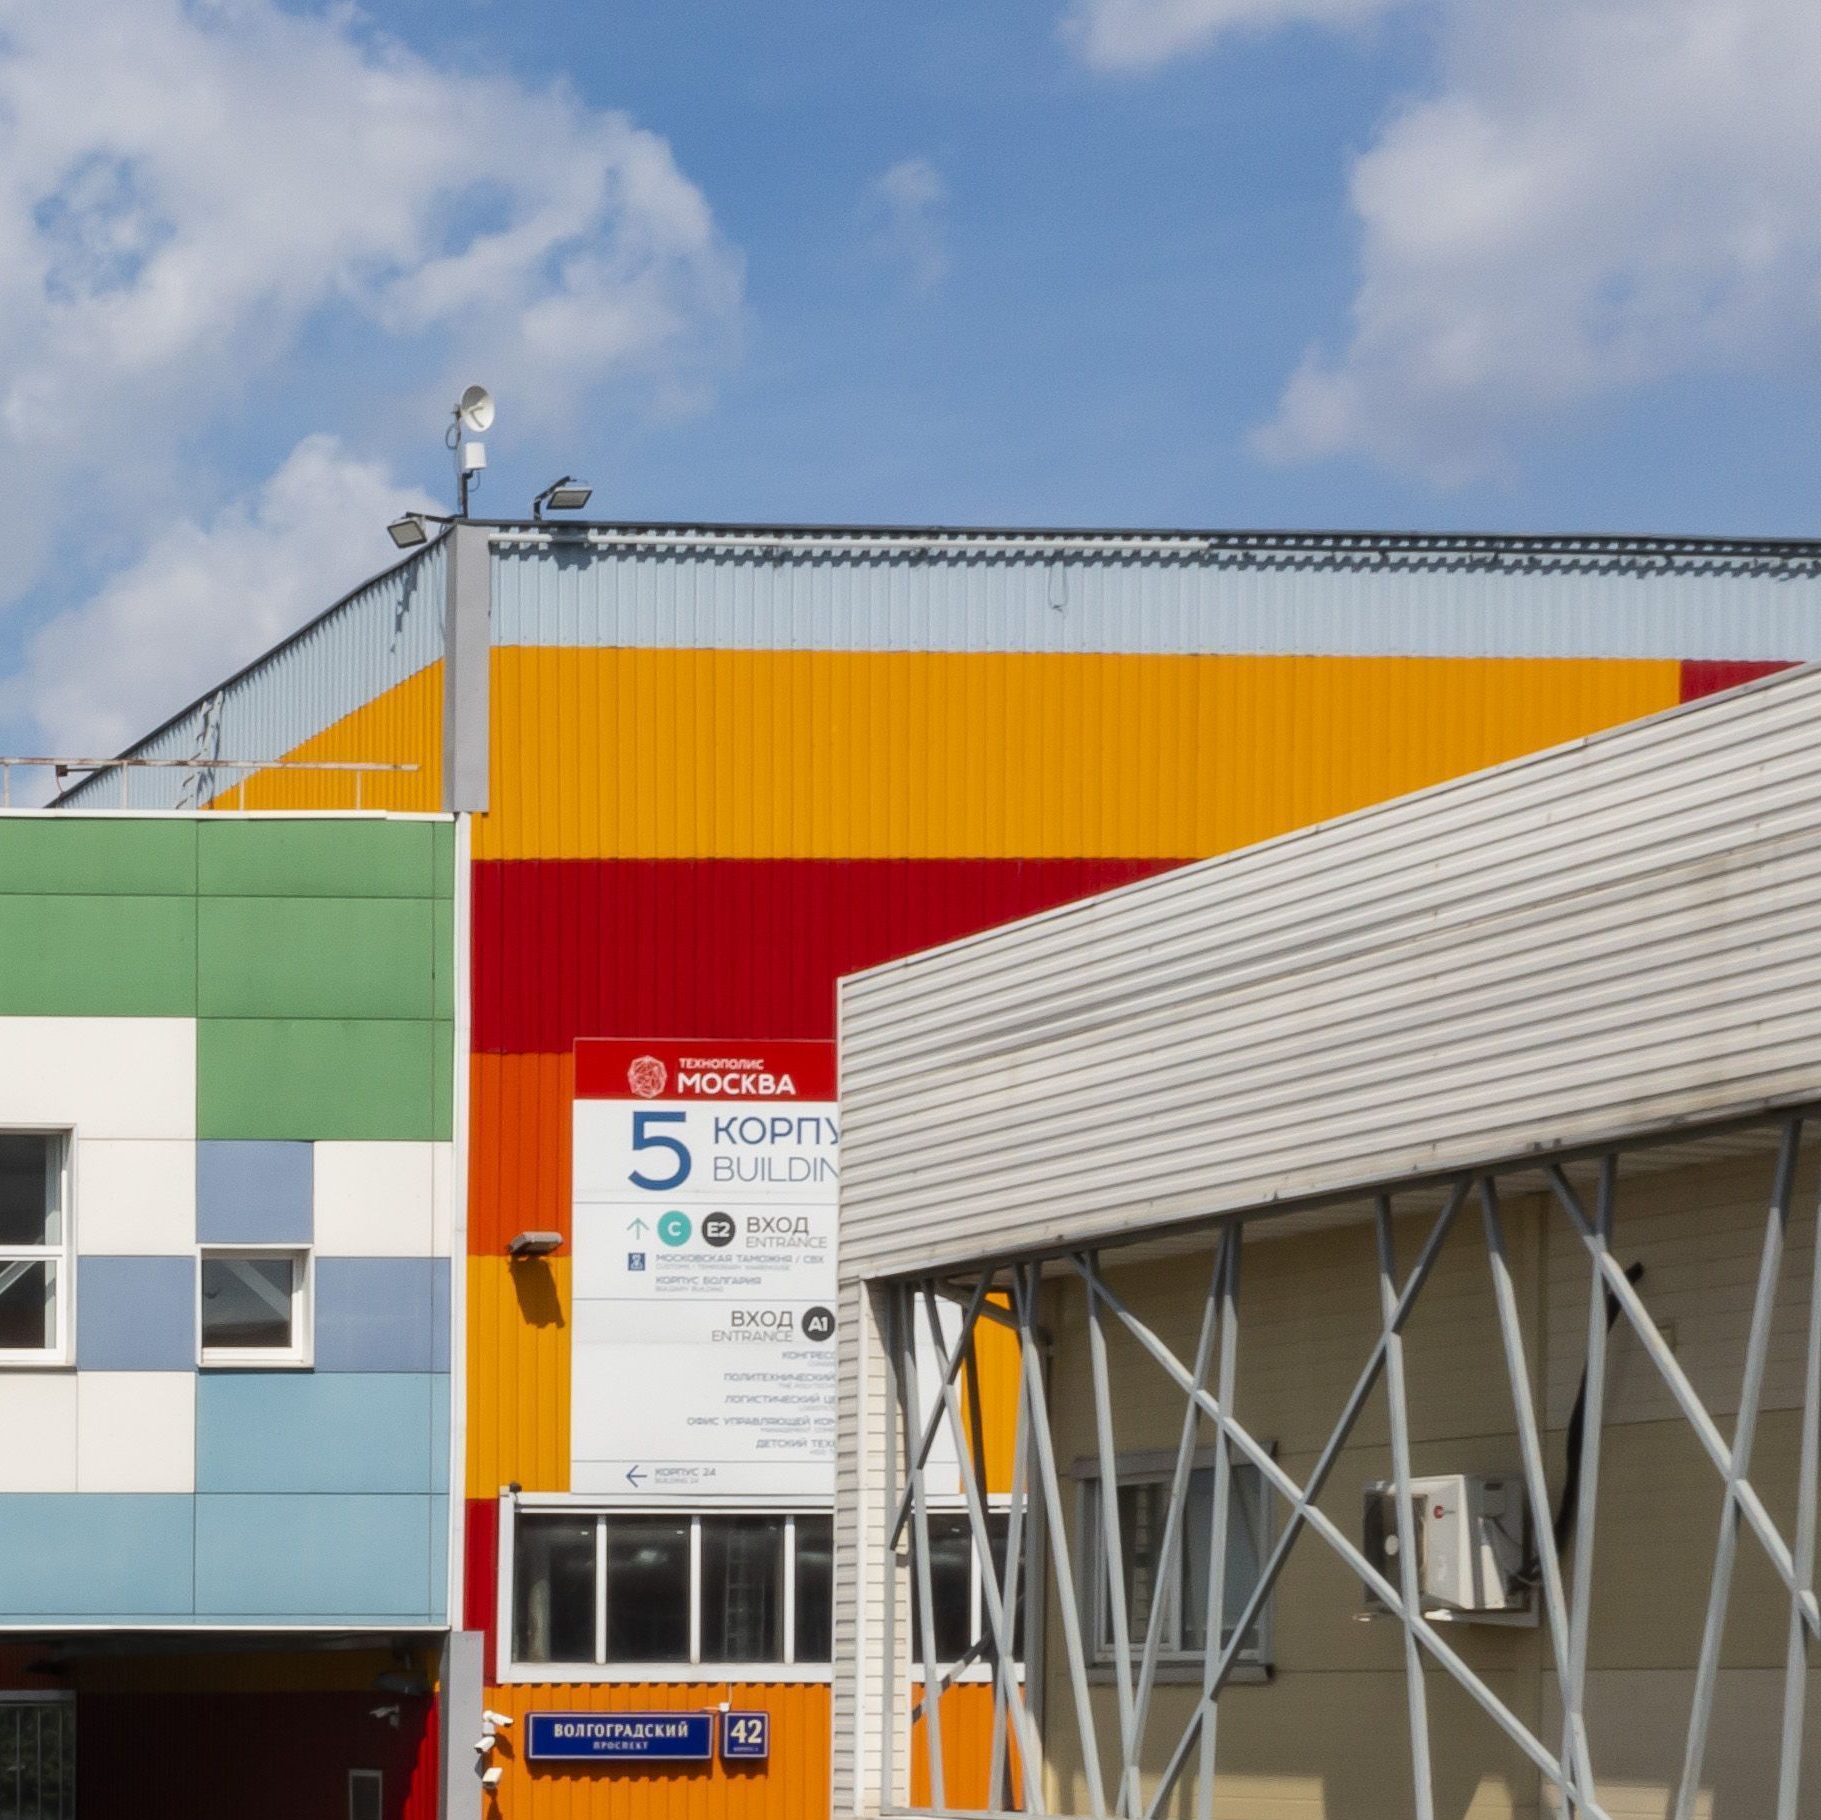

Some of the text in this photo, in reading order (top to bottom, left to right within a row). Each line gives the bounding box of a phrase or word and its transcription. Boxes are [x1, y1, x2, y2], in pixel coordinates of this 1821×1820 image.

[679, 1057, 764, 1070] ТЕХНОПОЛИС
[677, 1073, 796, 1095] МОСКВА
[628, 1111, 692, 1191] 5
[746, 1217, 809, 1236] ВХОД
[746, 1236, 828, 1248] ENTRANCE
[656, 1276, 699, 1285] КОРПУС
[731, 1310, 793, 1329] ВХОД
[711, 1330, 793, 1342] ENTRANCE
[554, 1721, 689, 1738] ВОЛГОГРАДСКИЙ
[730, 1719, 763, 1744] 42
[593, 1741, 648, 1750] ПРОСПЕКТ
